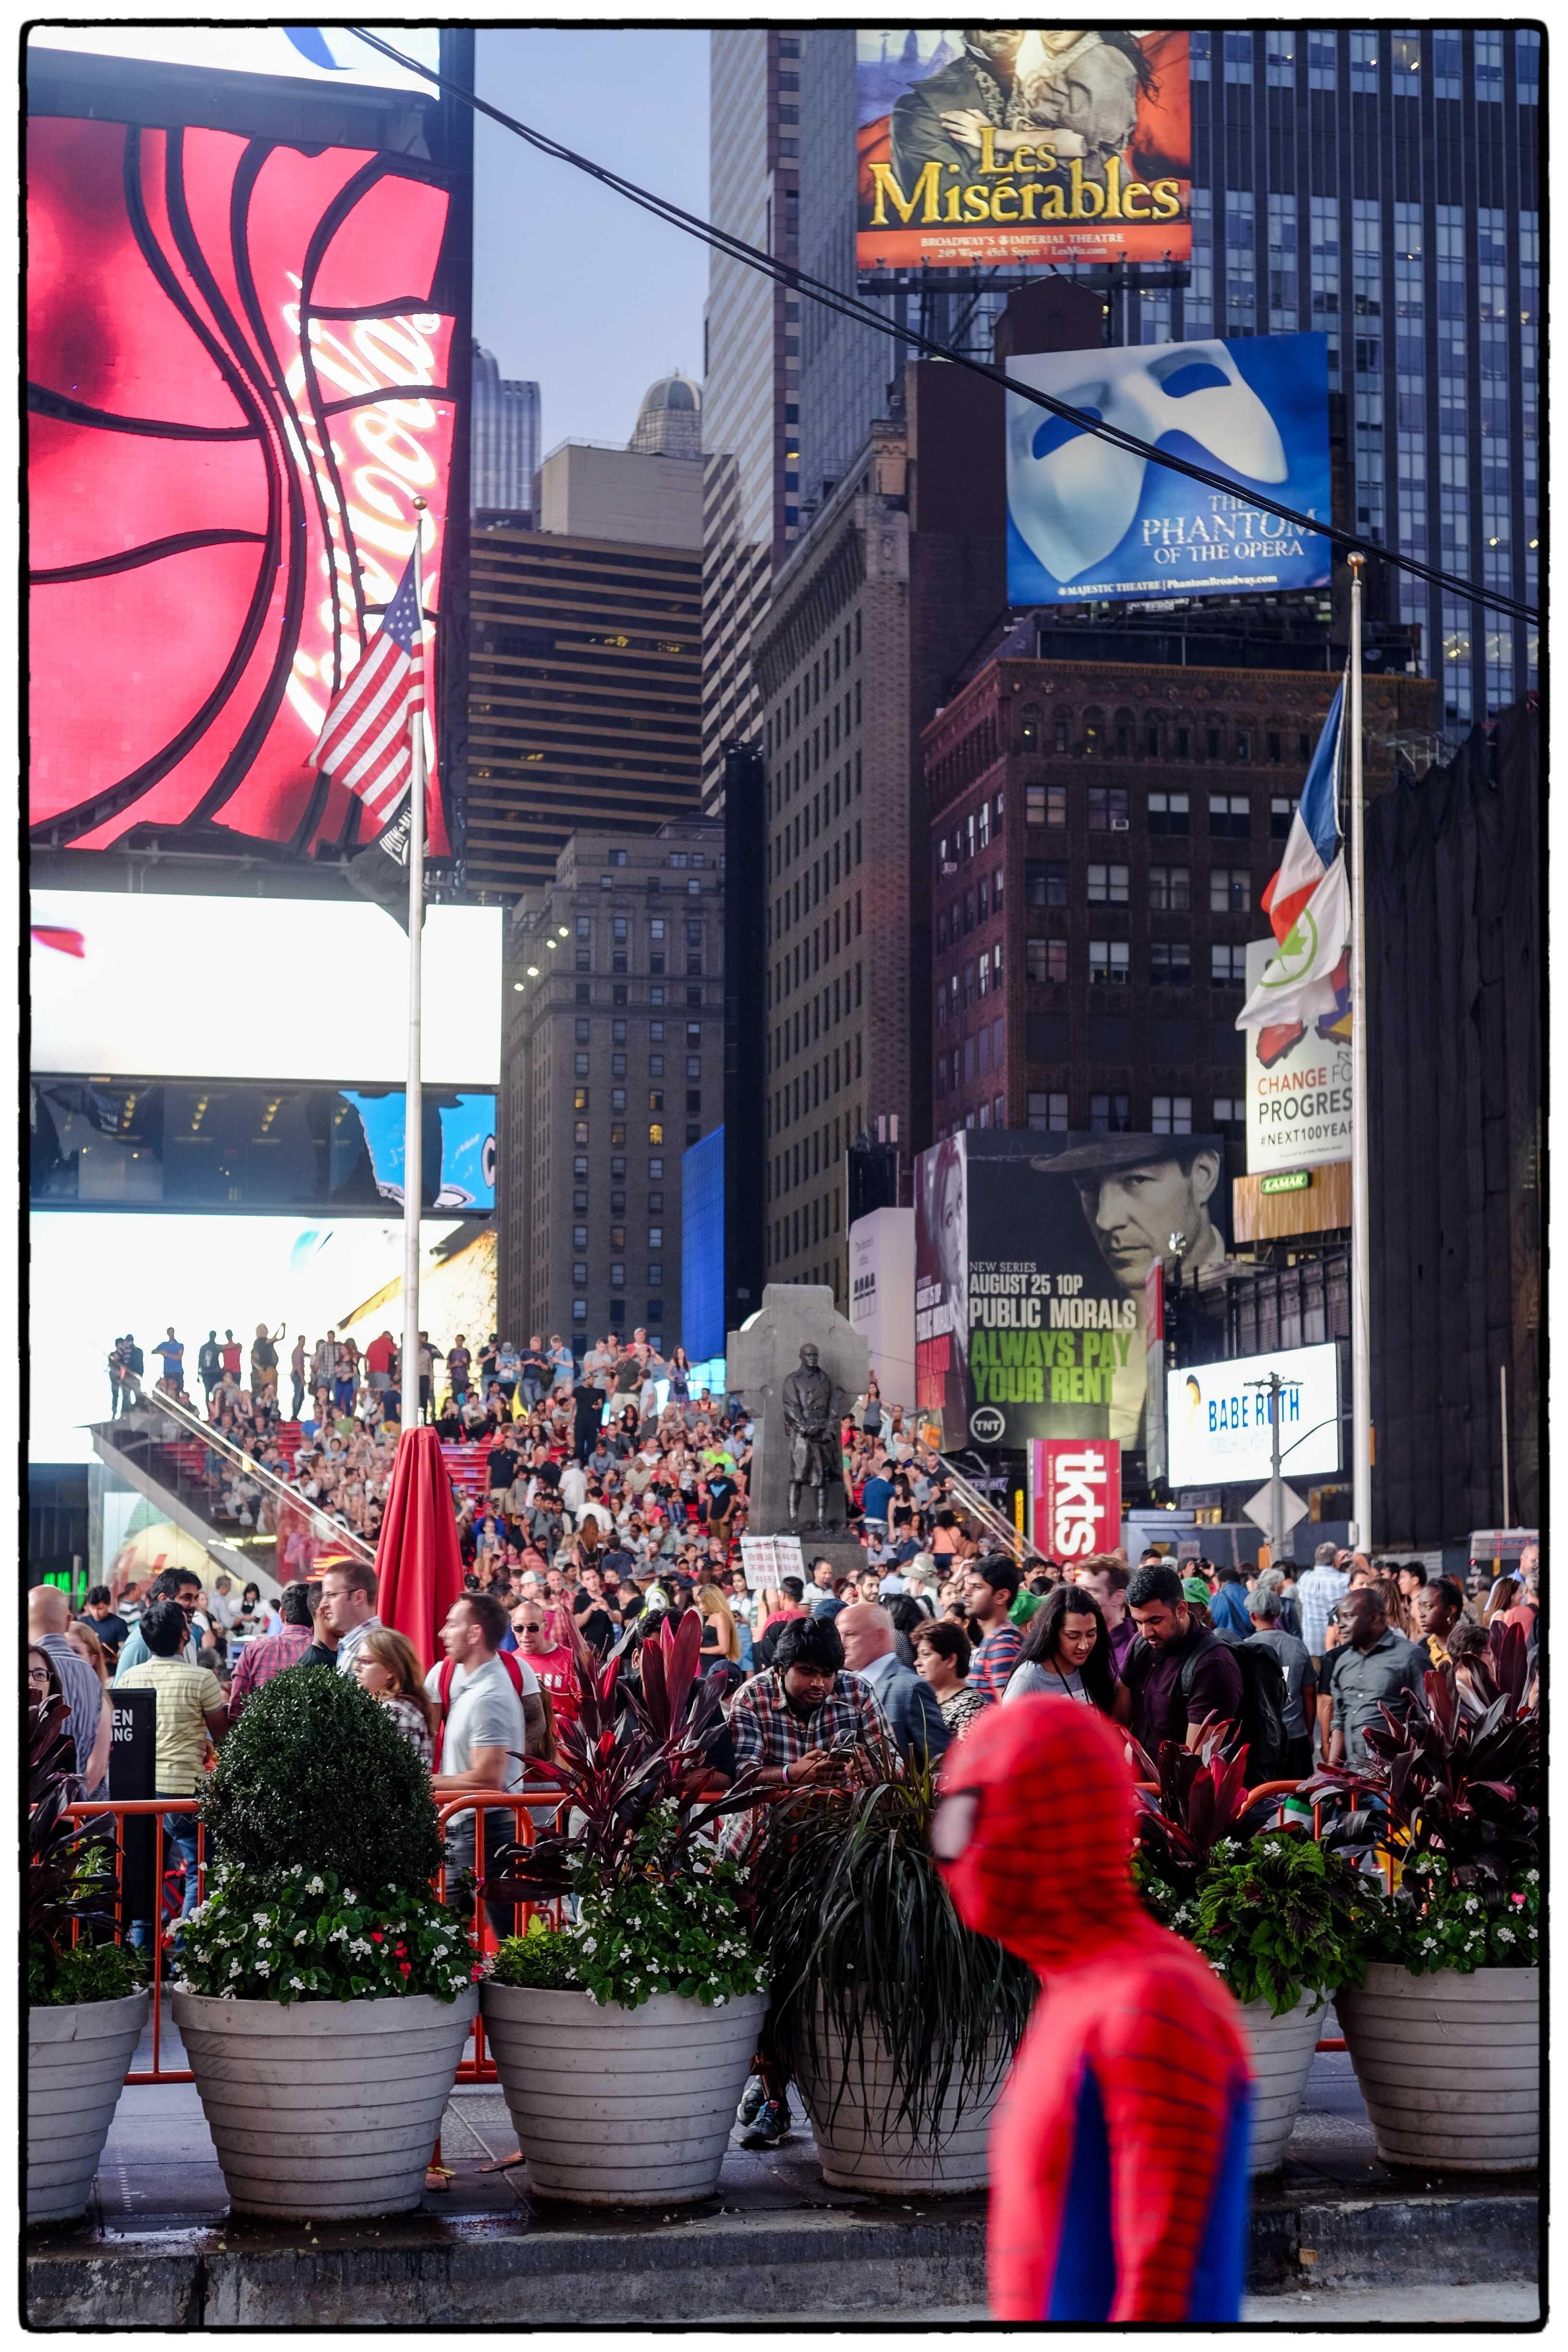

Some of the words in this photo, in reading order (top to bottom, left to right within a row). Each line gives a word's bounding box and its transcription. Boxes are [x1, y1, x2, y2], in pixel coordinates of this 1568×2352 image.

[979, 126, 1057, 174] Les
[868, 156, 1180, 225] Misérables
[1010, 234, 1065, 244] IMPERIAL
[1068, 233, 1125, 243] THEATRE
[1208, 494, 1250, 512] THE
[1141, 508, 1319, 547] PHANTOM
[1154, 548, 1180, 565] OF
[1187, 544, 1229, 562] THE
[1234, 540, 1305, 560] OPERA
[1067, 583, 1115, 596] MAJESTIC
[1116, 580, 1161, 592] THEATRE
[1166, 575, 1278, 589] PhantomBroadway.com
[1258, 1067, 1327, 1096] CHANGE
[1331, 1063, 1353, 1084] FO
[1258, 1087, 1353, 1124] PROGRES
[1265, 1176, 1303, 1192] LAMAR
[969, 1262, 996, 1273] NEW
[1000, 1262, 1037, 1273] SERIES
[969, 1274, 1028, 1295] AUGUST
[1030, 1274, 1051, 1295] 25
[1057, 1274, 1083, 1296] 10P
[969, 1297, 1041, 1328] PUBLIC
[1050, 1298, 1137, 1329] MORALS
[970, 1331, 1076, 1368] ALWAYS
[1083, 1331, 1132, 1368] PAY
[971, 1367, 1044, 1403] YOUR
[1051, 1368, 1116, 1404] RENT
[975, 1420, 1001, 1431] TNT
[1209, 1396, 1249, 1432] BABE
[1055, 1449, 1107, 1556] tkts
